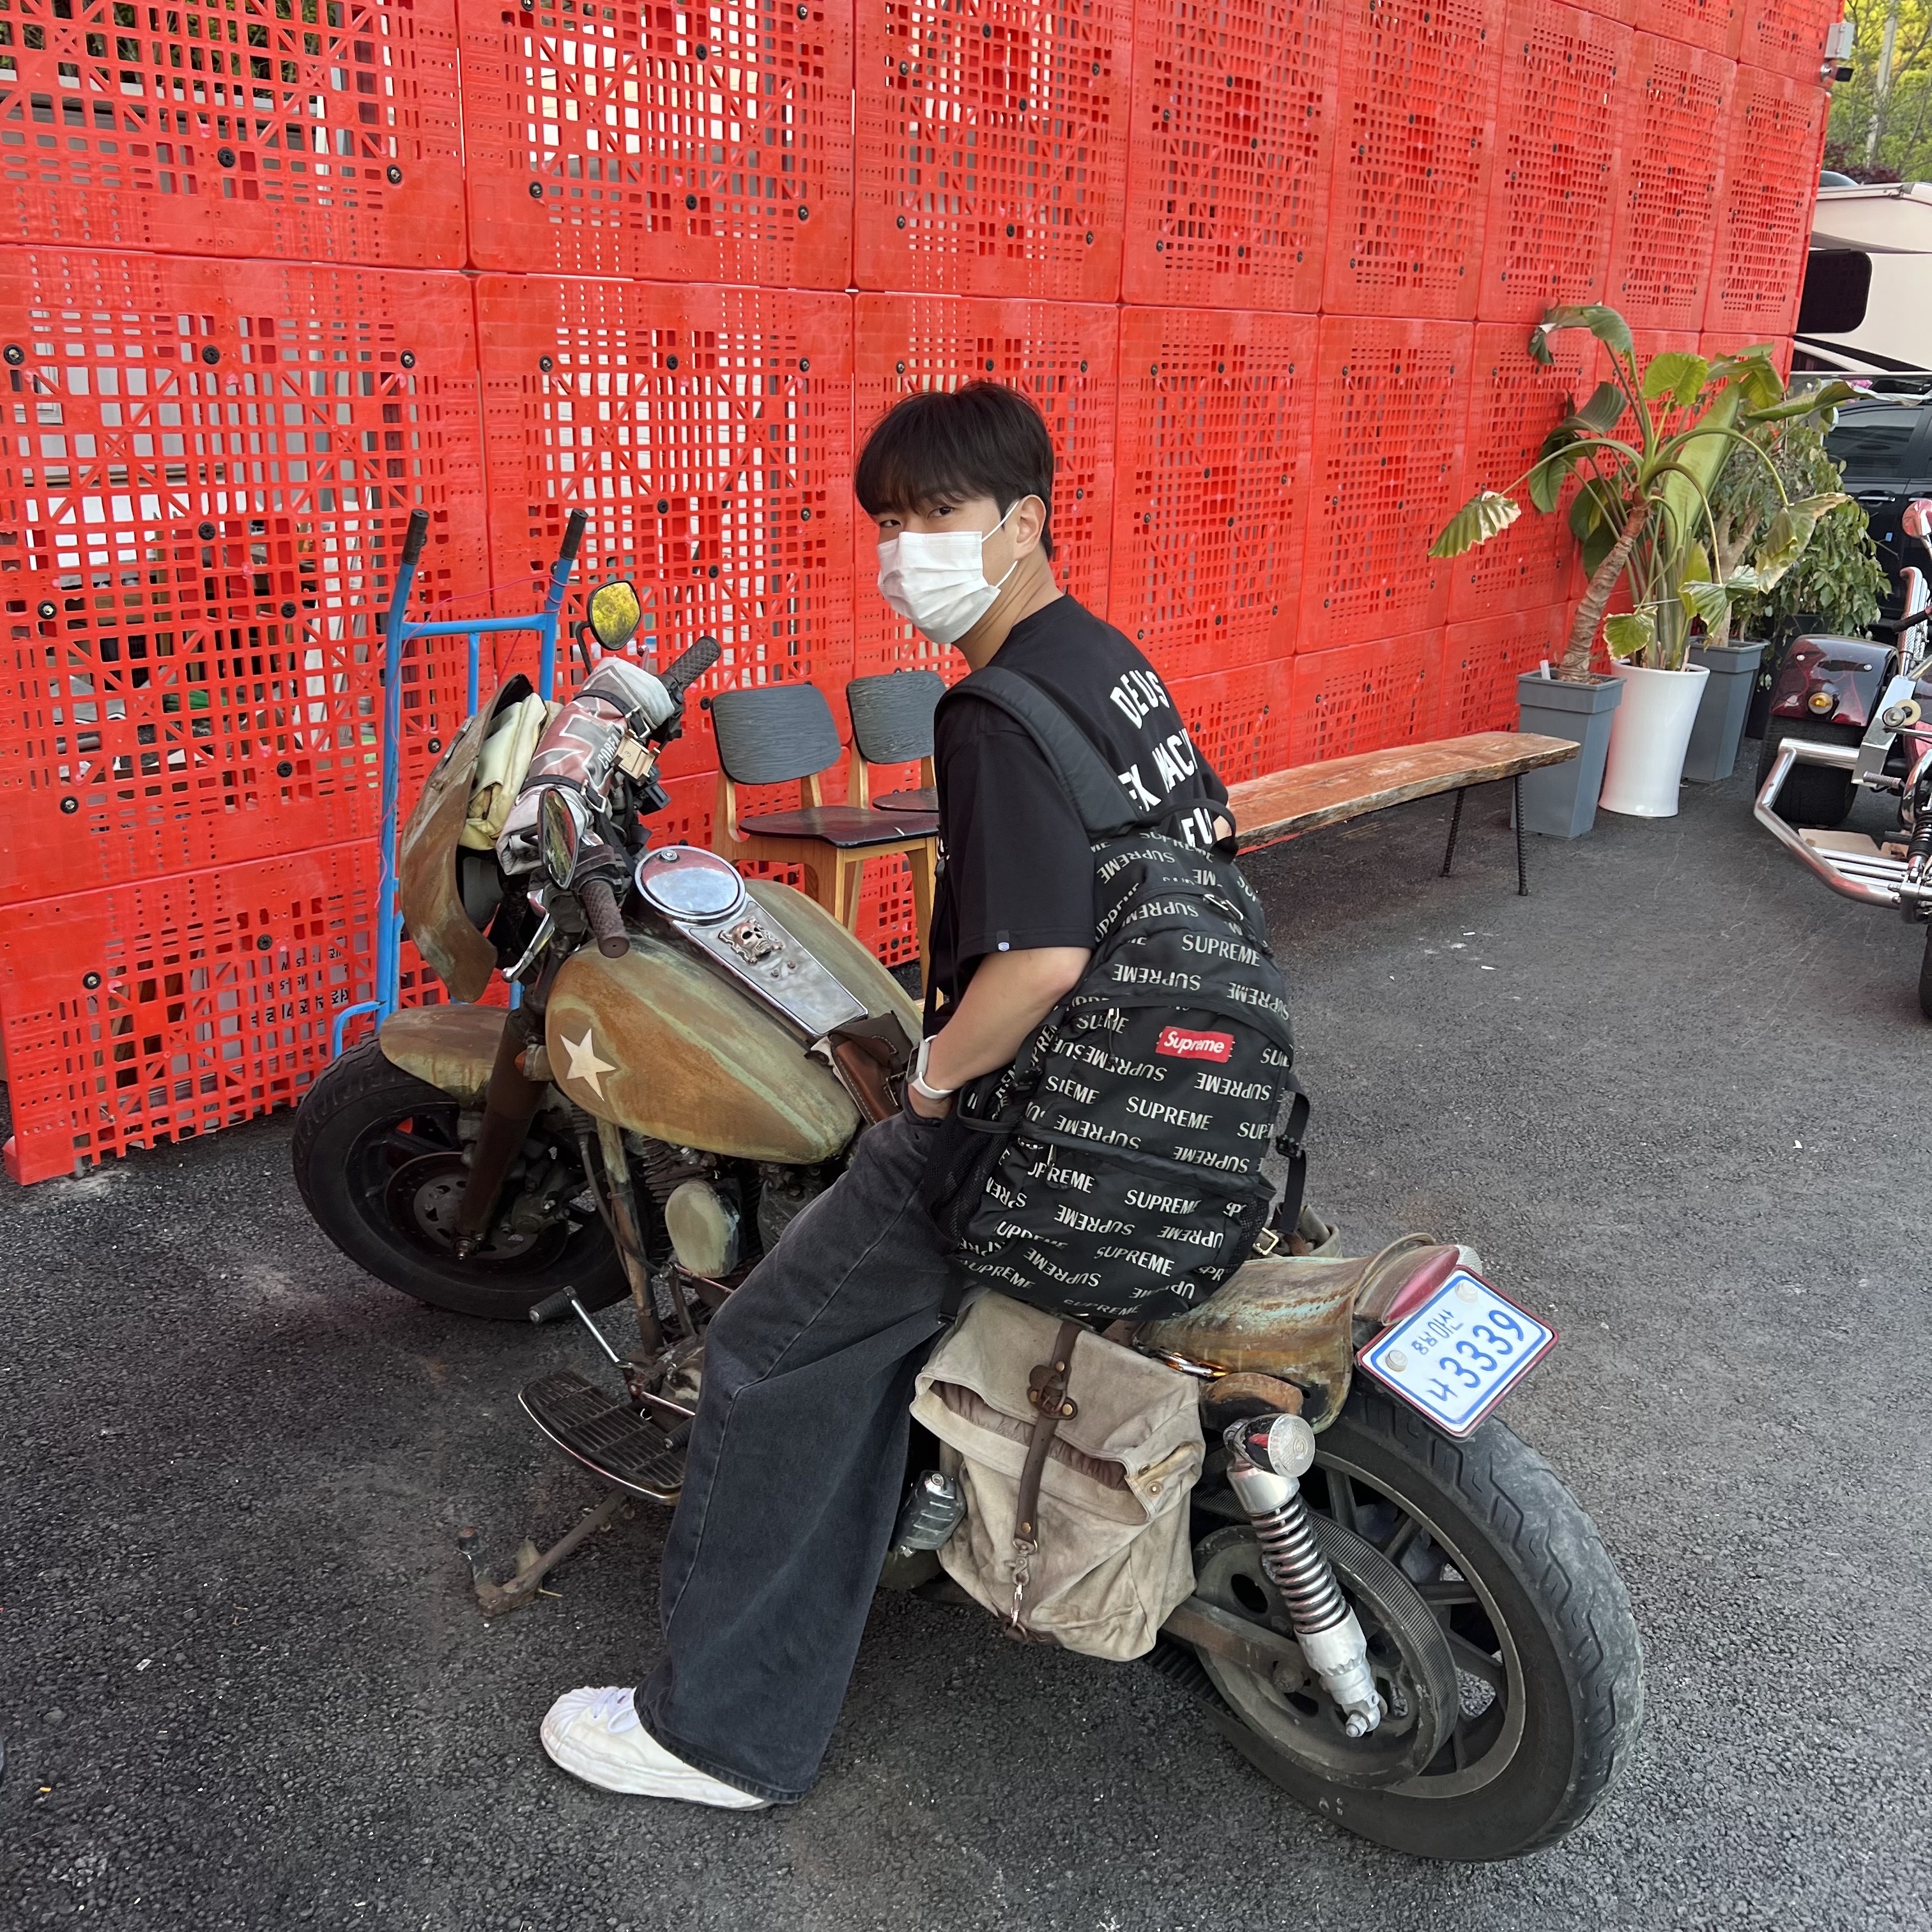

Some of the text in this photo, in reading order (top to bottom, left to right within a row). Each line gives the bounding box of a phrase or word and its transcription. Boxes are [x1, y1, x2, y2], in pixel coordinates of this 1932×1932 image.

[1110, 670, 1170, 729] DEUS
[1096, 849, 1176, 884] SUPREME
[1121, 901, 1199, 928] SUPREM
[1182, 934, 1261, 967] SUPREME
[1112, 963, 1202, 991] SUPREME
[1193, 1072, 1272, 1101] SUPREME
[1126, 1096, 1214, 1131] SUPREME
[1054, 1114, 1142, 1150] SUPREME
[1173, 1146, 1250, 1173] SUPREME
[1054, 1204, 1136, 1236] SUPREME
[1157, 1225, 1224, 1249] UPREME
[1023, 1247, 1102, 1287] SUPREME
[1094, 1246, 1175, 1277] SUPREME
[1427, 1309, 1464, 1339] 아산
